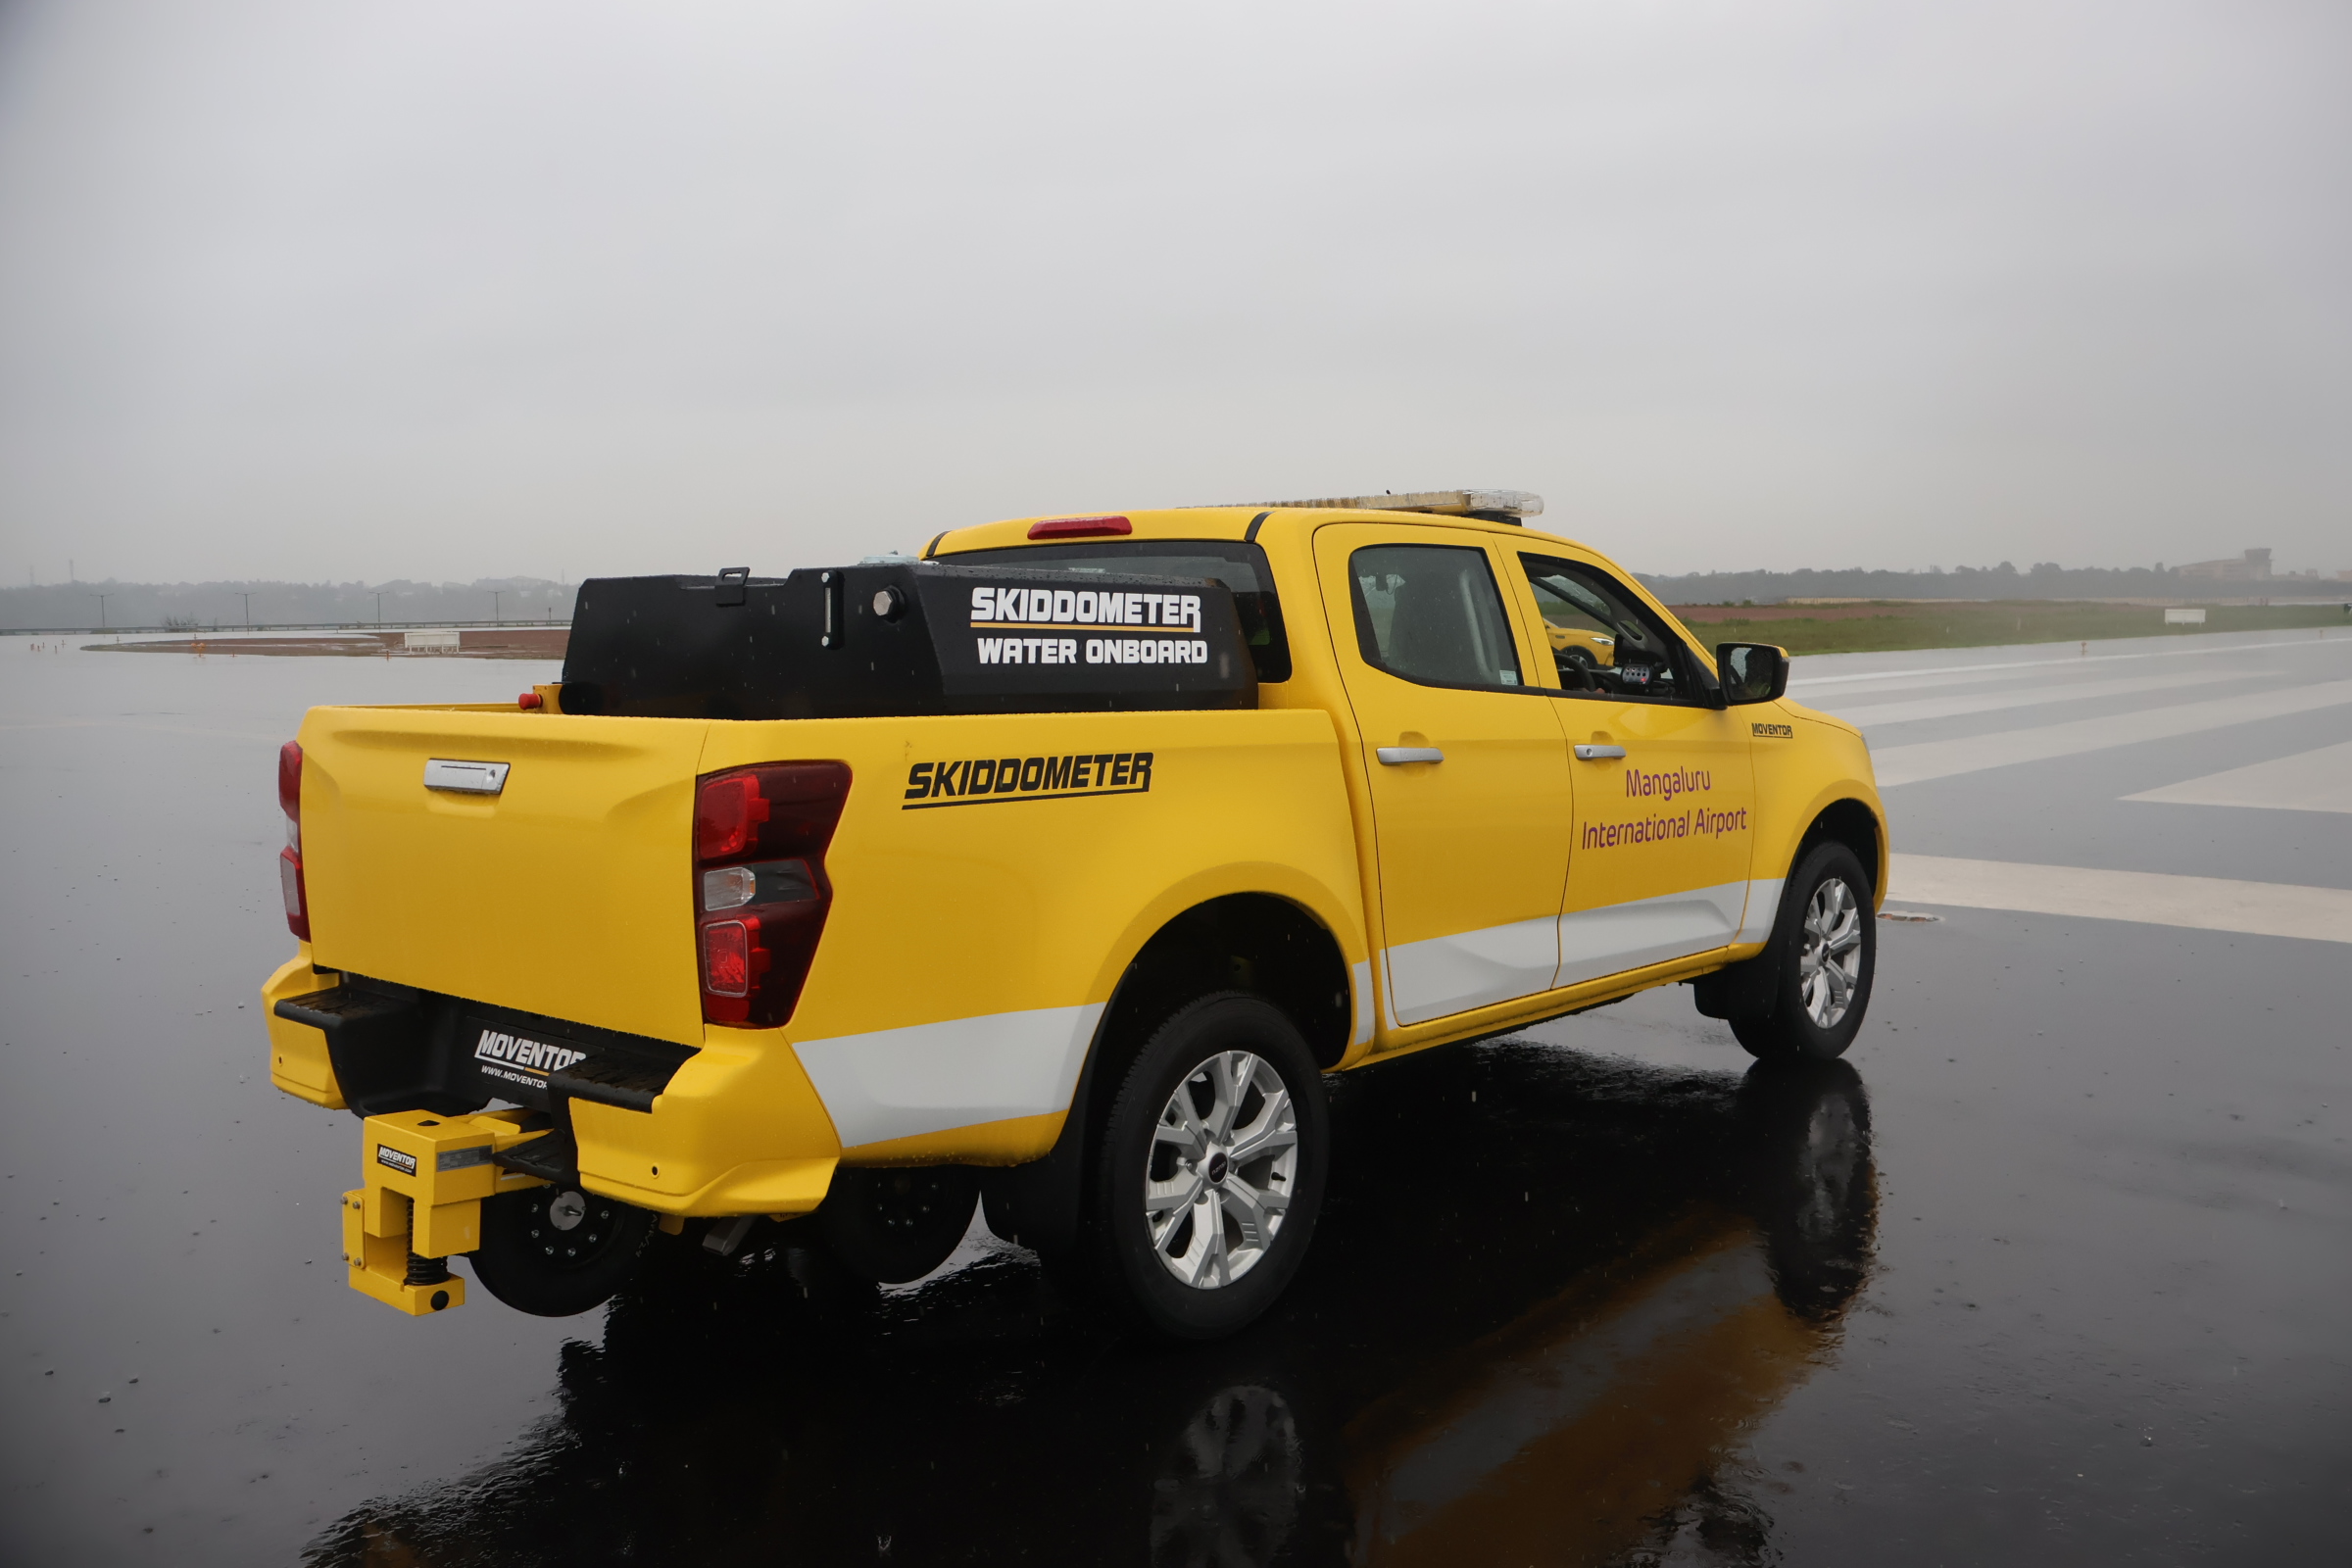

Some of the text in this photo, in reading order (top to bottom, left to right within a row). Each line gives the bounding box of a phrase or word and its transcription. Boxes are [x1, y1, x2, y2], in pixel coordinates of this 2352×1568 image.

[970, 587, 1201, 632] SKIDDOMETER
[977, 638, 1208, 664] WATER ONBOARD
[1751, 722, 1793, 739] MOVENTOR
[902, 752, 1154, 808] SKIDDOMETER
[1626, 765, 1711, 802] Mangaluru
[1582, 807, 1747, 851] International Airport
[378, 1146, 416, 1169] MOVENTOR
